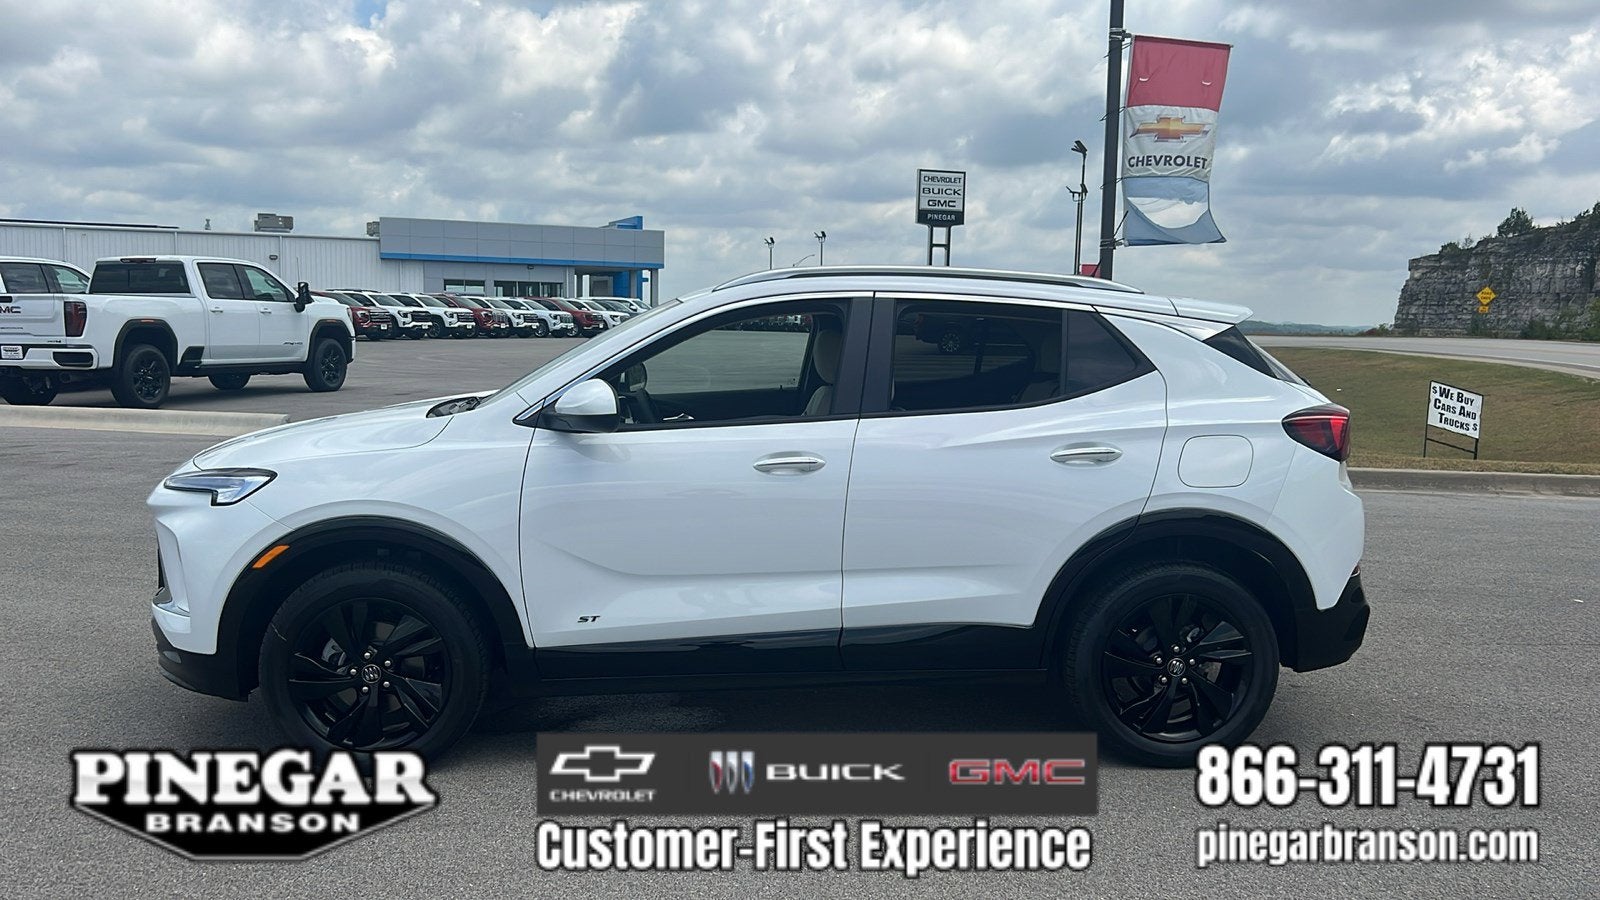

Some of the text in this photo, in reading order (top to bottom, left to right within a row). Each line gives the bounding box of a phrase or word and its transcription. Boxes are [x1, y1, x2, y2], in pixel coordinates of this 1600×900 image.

[1128, 155, 1208, 169] CHEVROLET
[923, 175, 962, 184] CHEVROLET
[922, 187, 962, 196] BUICK
[927, 199, 957, 208] GMC
[927, 213, 956, 221] PINEGAR
[0, 306, 21, 314] MC
[1439, 386, 1455, 401] WE
[1456, 391, 1475, 406] BUY
[1433, 398, 1477, 420] CARS AND
[1438, 412, 1470, 431] TRUCKS
[577, 615, 601, 623] ST
